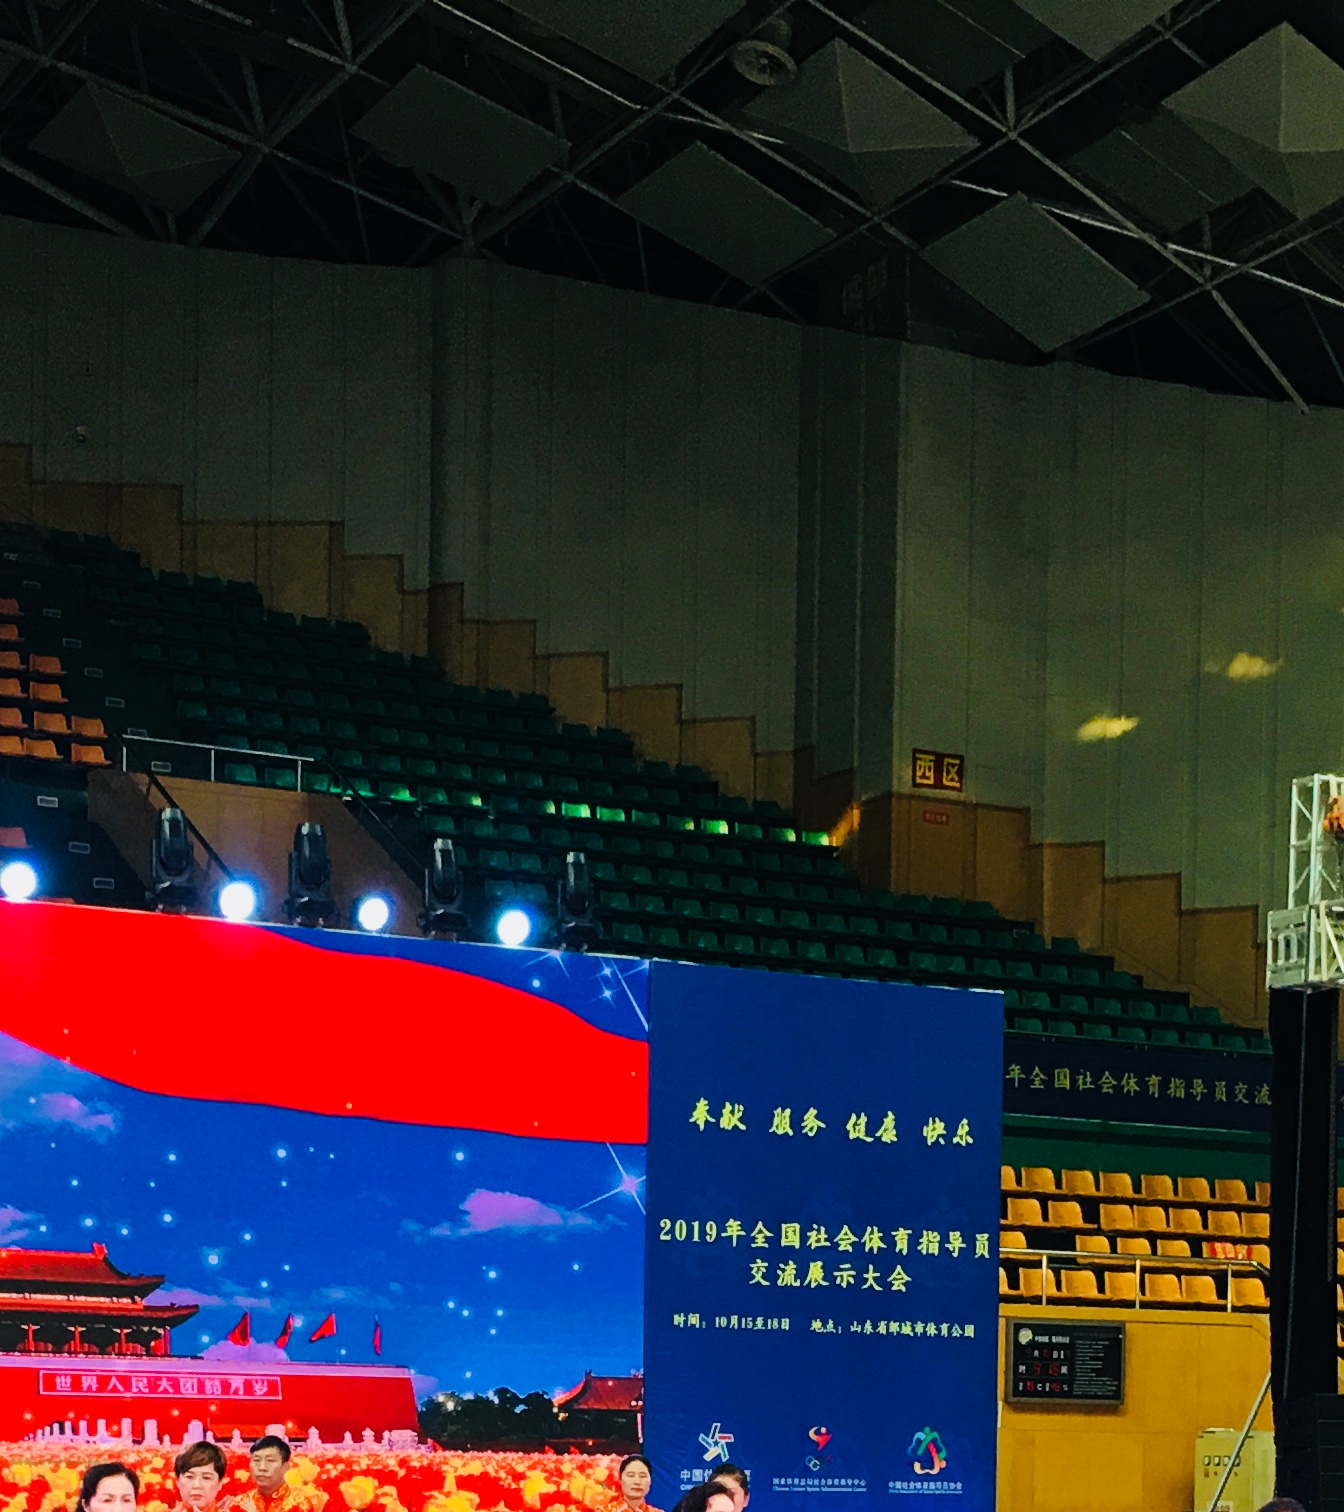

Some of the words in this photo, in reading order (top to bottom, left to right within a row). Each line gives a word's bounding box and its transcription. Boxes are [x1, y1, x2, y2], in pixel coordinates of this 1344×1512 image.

[915, 753, 961, 788] 西区
[689, 1097, 747, 1132] 奉献
[769, 1106, 826, 1137] 服务
[846, 1111, 898, 1144] 健康
[923, 1117, 974, 1147] 快乐
[659, 1218, 990, 1259] 2019年全国社会体育指导员
[749, 1258, 913, 1293] 交流展示大会
[55, 1375, 269, 1396] 世界人民大团结万岁
